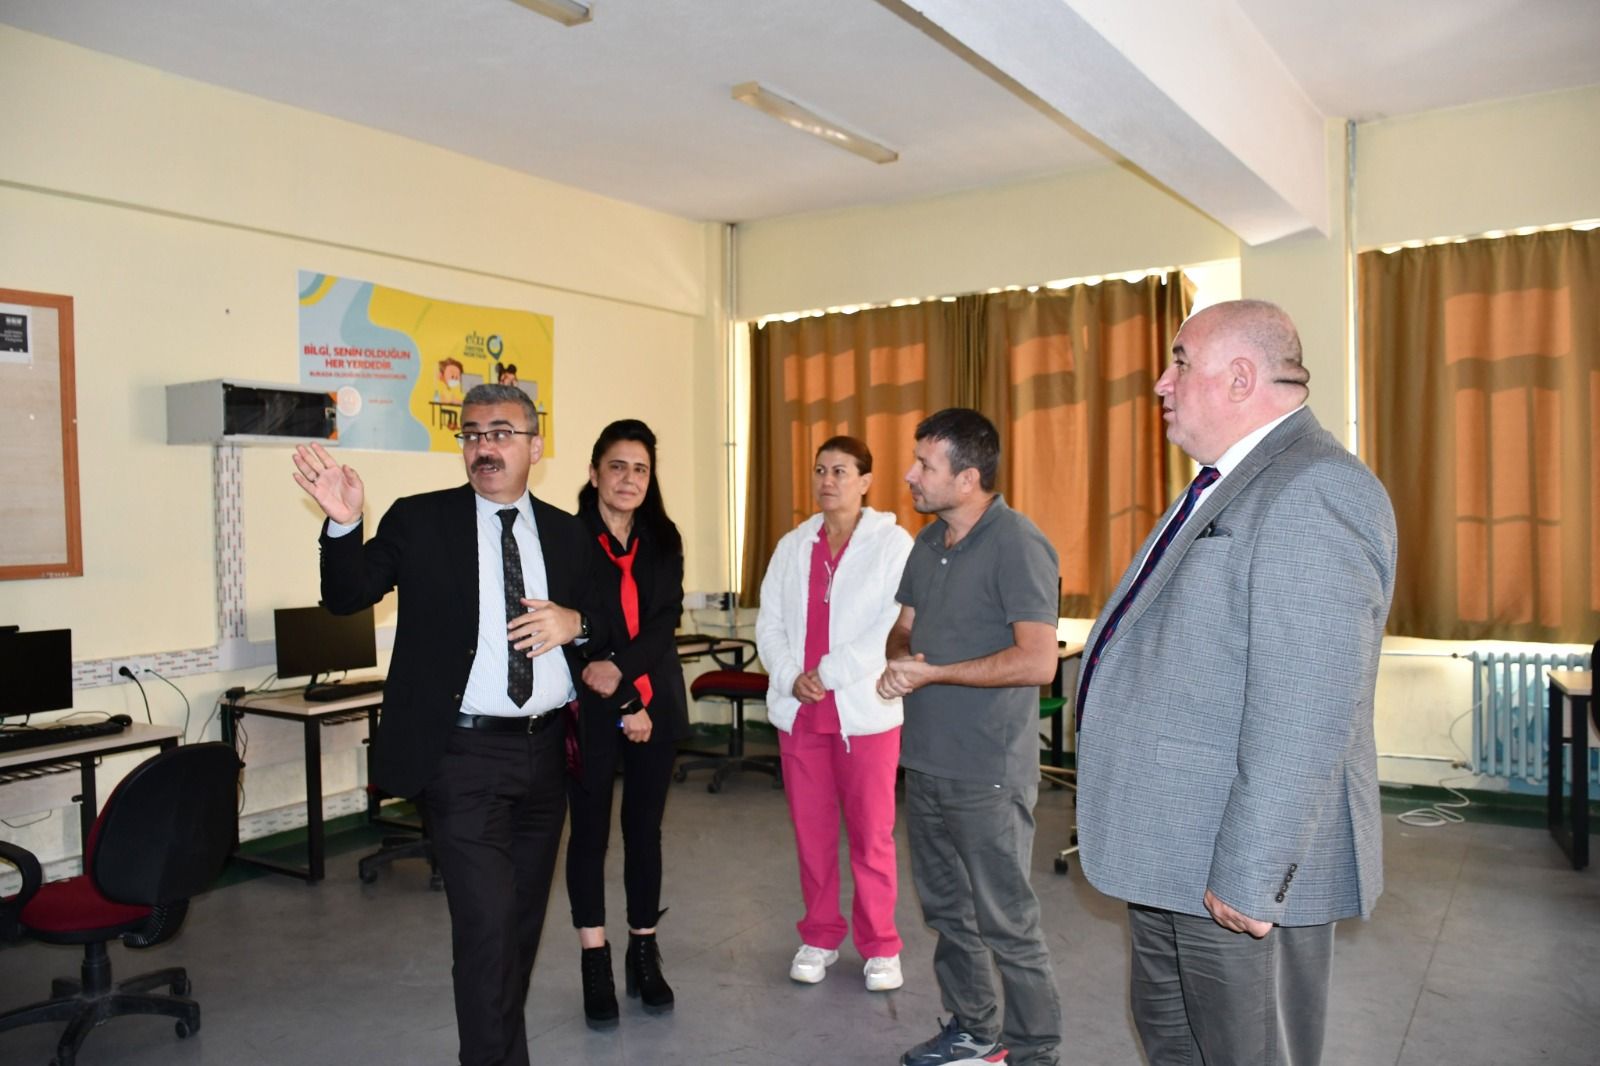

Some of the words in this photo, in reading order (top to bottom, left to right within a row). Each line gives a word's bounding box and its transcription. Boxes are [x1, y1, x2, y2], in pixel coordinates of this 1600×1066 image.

[303, 344, 331, 357] BİLGİ,
[333, 345, 362, 357] SENİN
[364, 347, 411, 360] OLDUĞUN
[325, 358, 345, 369] HER
